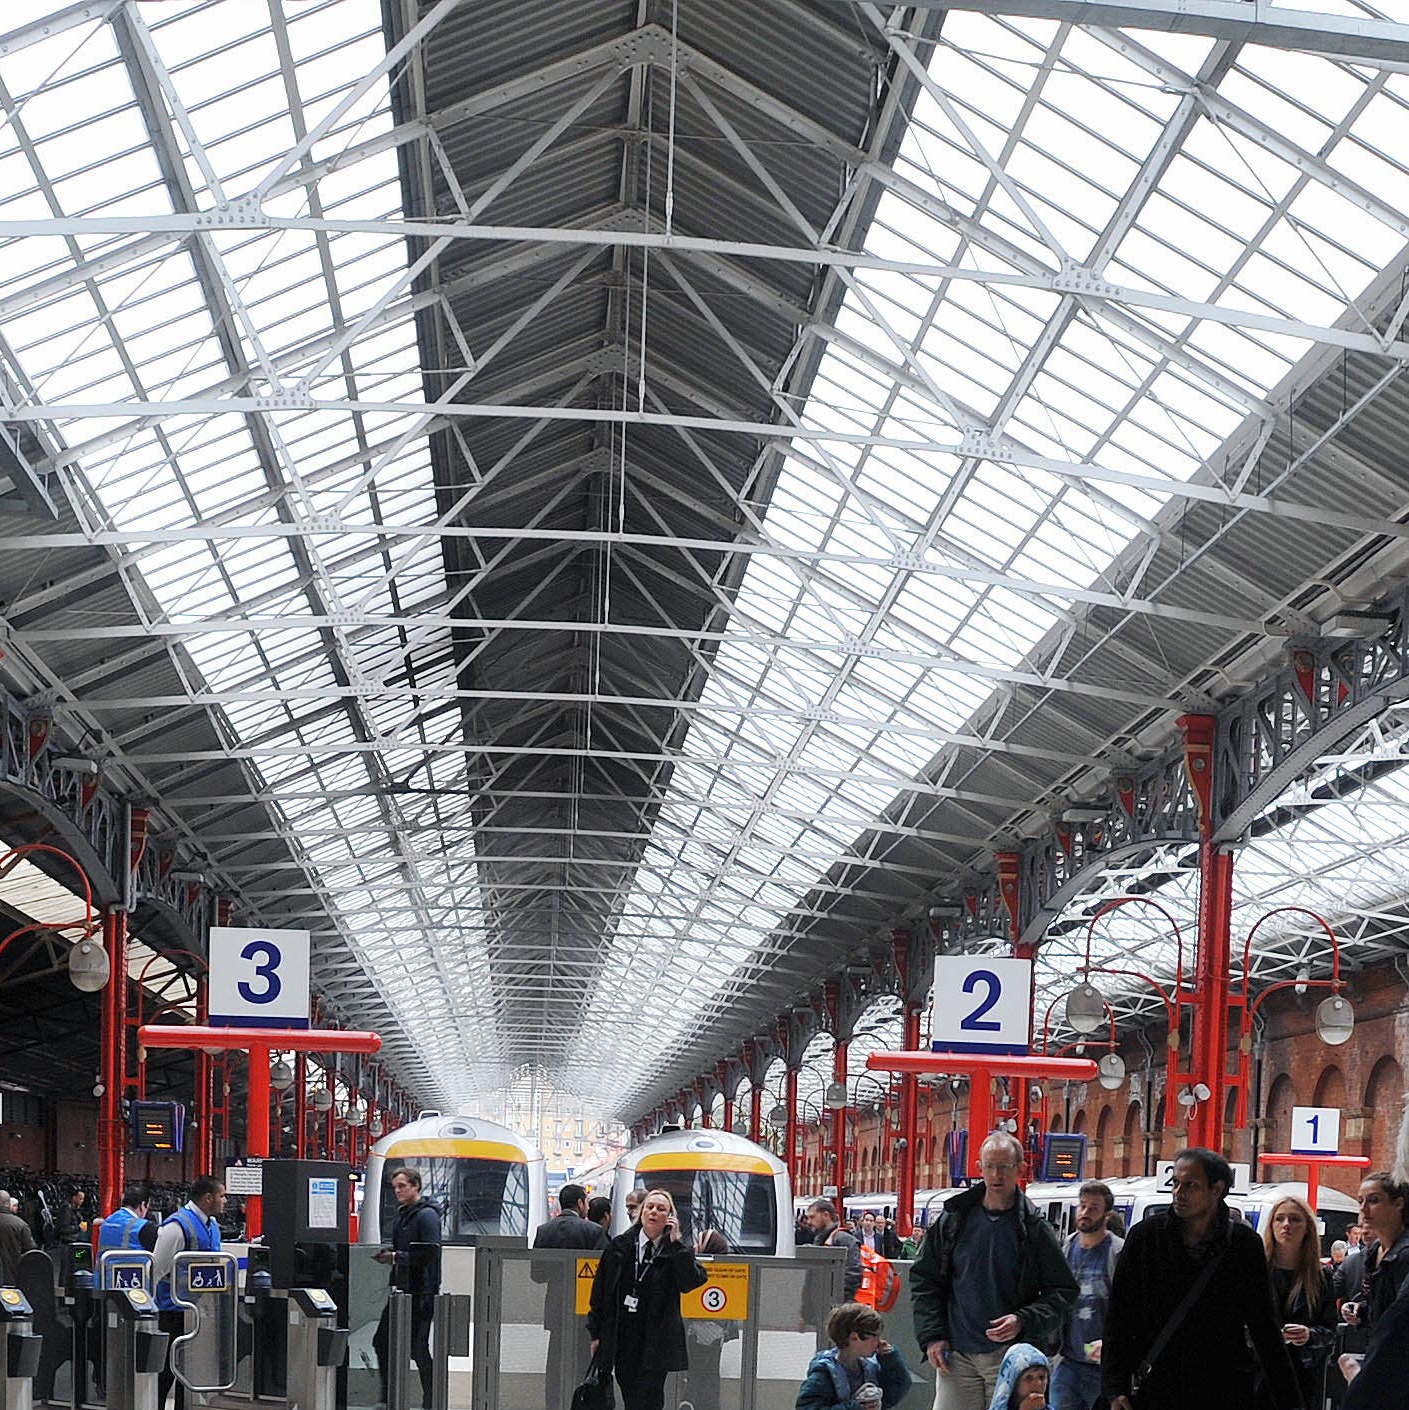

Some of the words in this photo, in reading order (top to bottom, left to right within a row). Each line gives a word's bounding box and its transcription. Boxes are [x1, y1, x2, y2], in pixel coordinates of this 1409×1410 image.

[237, 940, 282, 1005] 3
[960, 969, 1002, 1032] 2
[1306, 1114, 1319, 1145] 1
[1164, 1166, 1175, 1186] 2
[707, 1290, 721, 1308] 3
